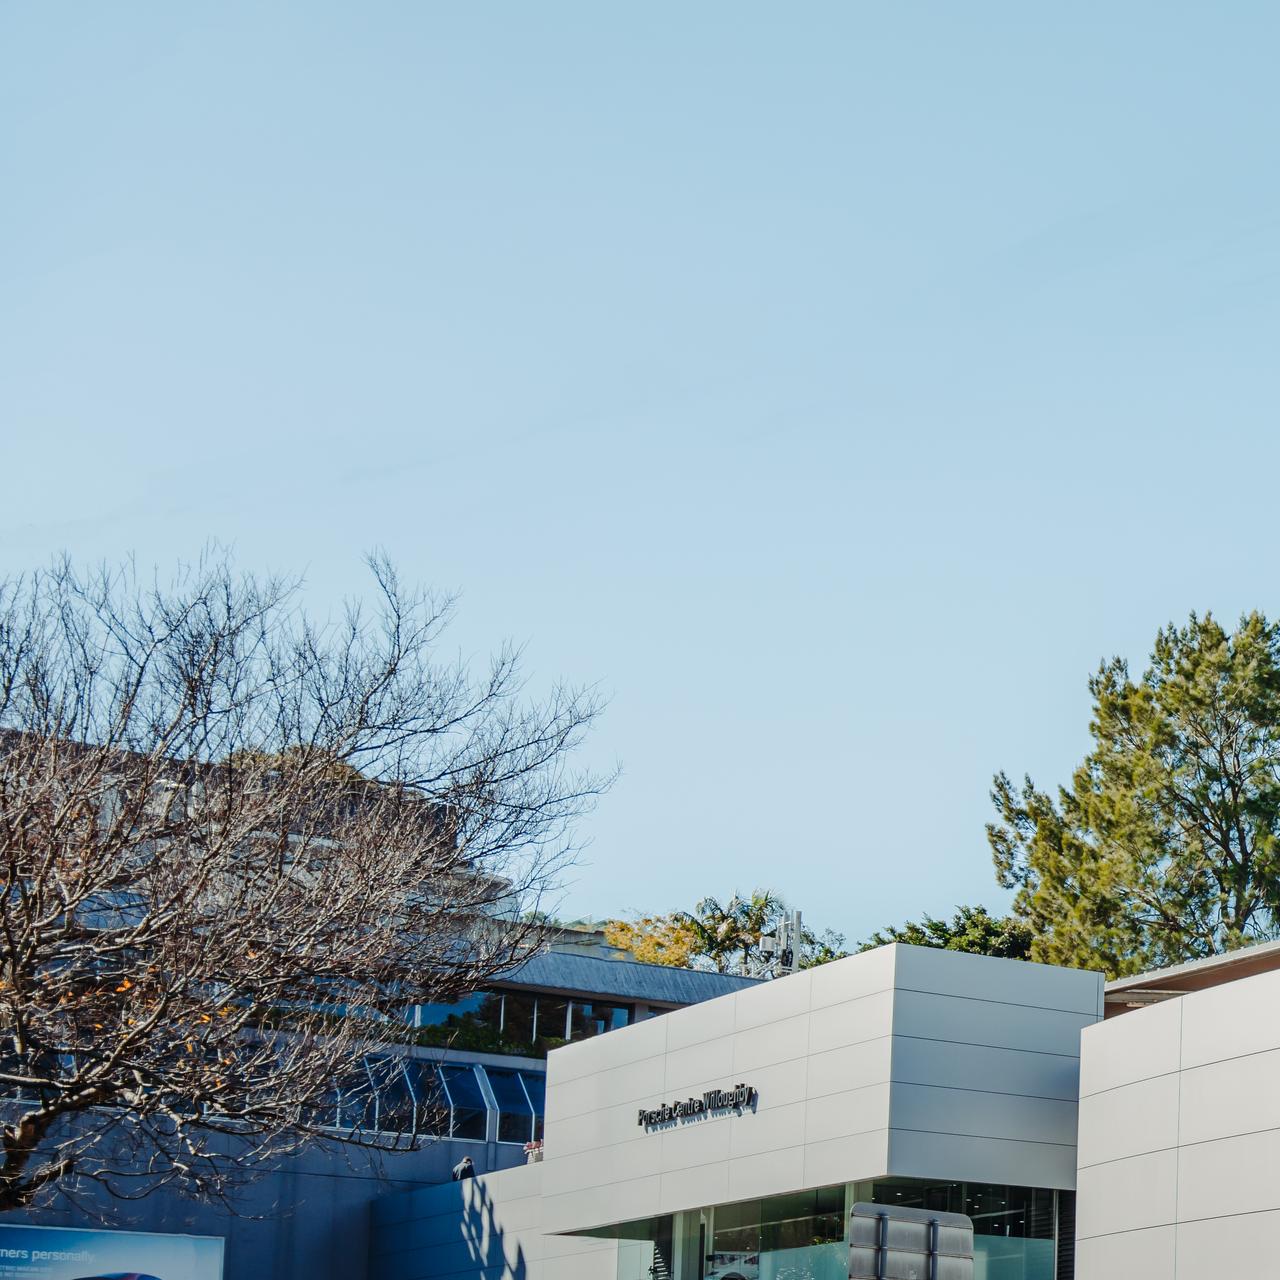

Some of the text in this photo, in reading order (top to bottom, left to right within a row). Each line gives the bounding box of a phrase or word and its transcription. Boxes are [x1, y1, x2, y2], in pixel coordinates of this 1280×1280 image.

[638, 1083, 758, 1126] Porsche Centre Willoughby
